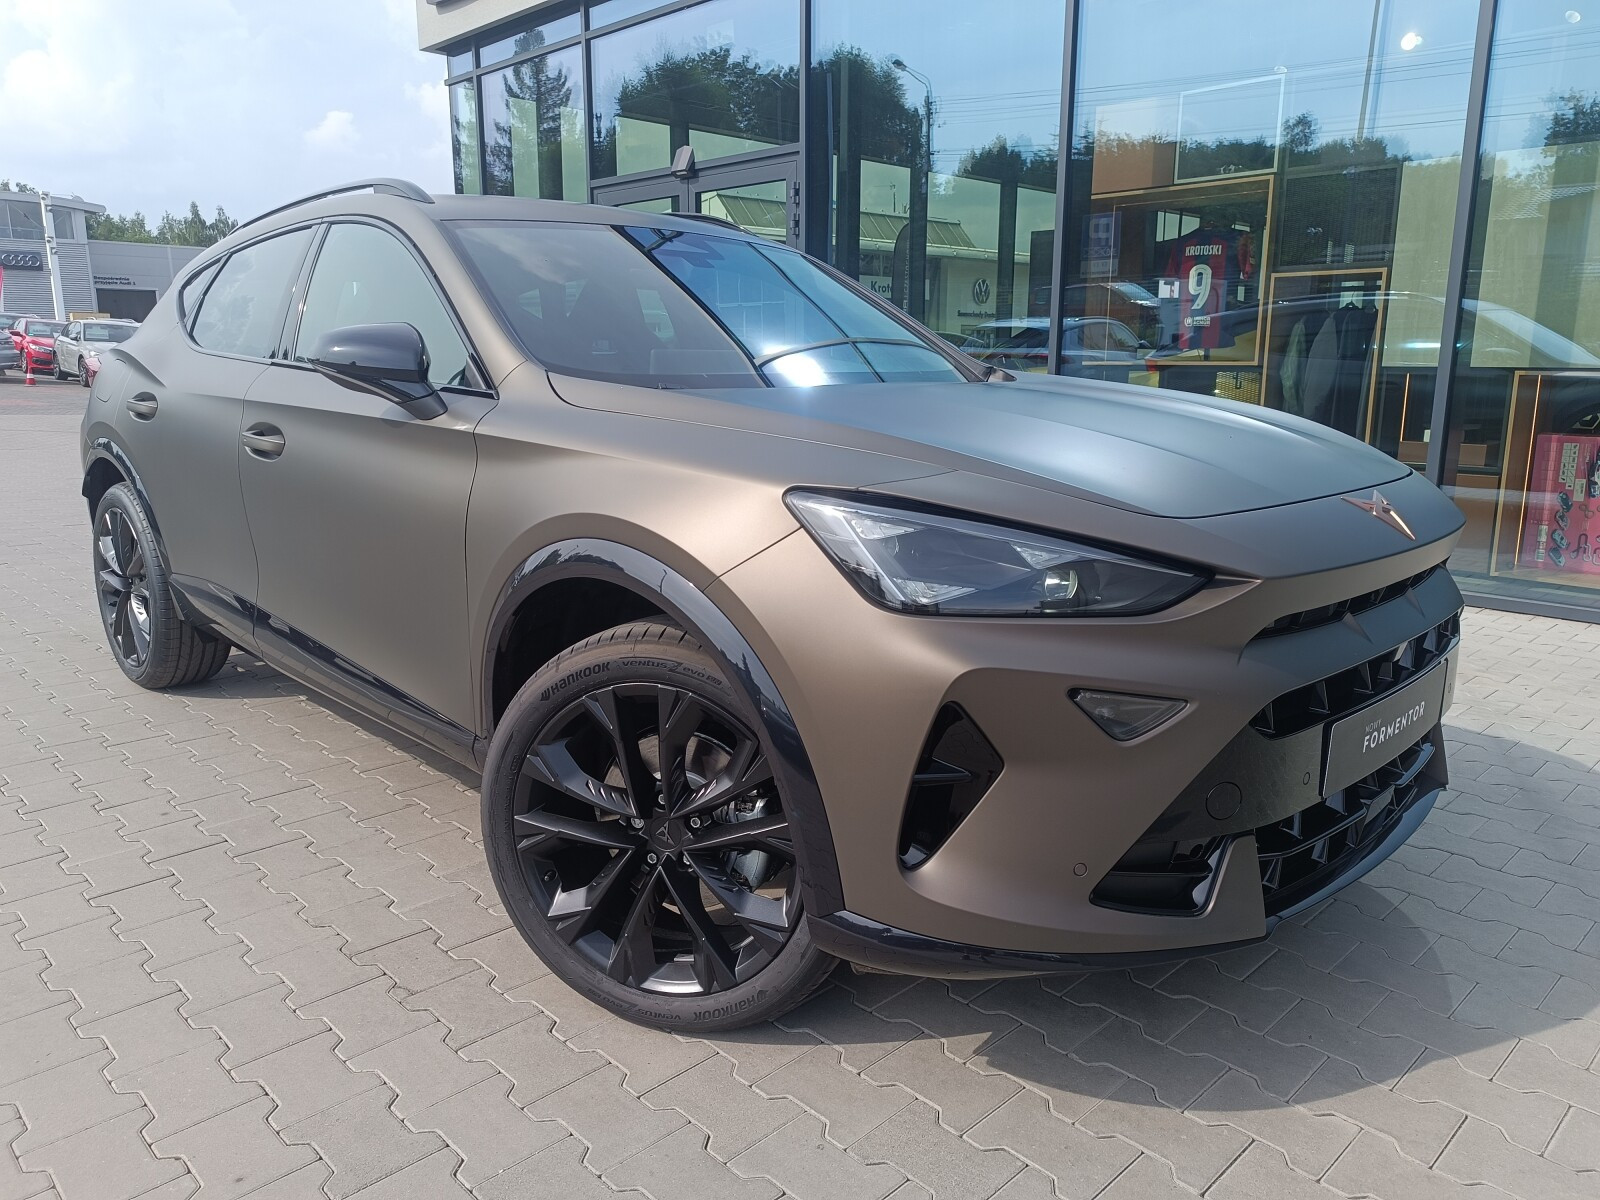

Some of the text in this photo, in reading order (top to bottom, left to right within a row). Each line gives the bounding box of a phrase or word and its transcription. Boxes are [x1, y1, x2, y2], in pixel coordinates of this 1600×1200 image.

[1185, 244, 1222, 256] KROTOSKI
[870, 280, 892, 293] Krot
[1188, 263, 1213, 310] 9
[1362, 701, 1425, 753] FORMENTOR
